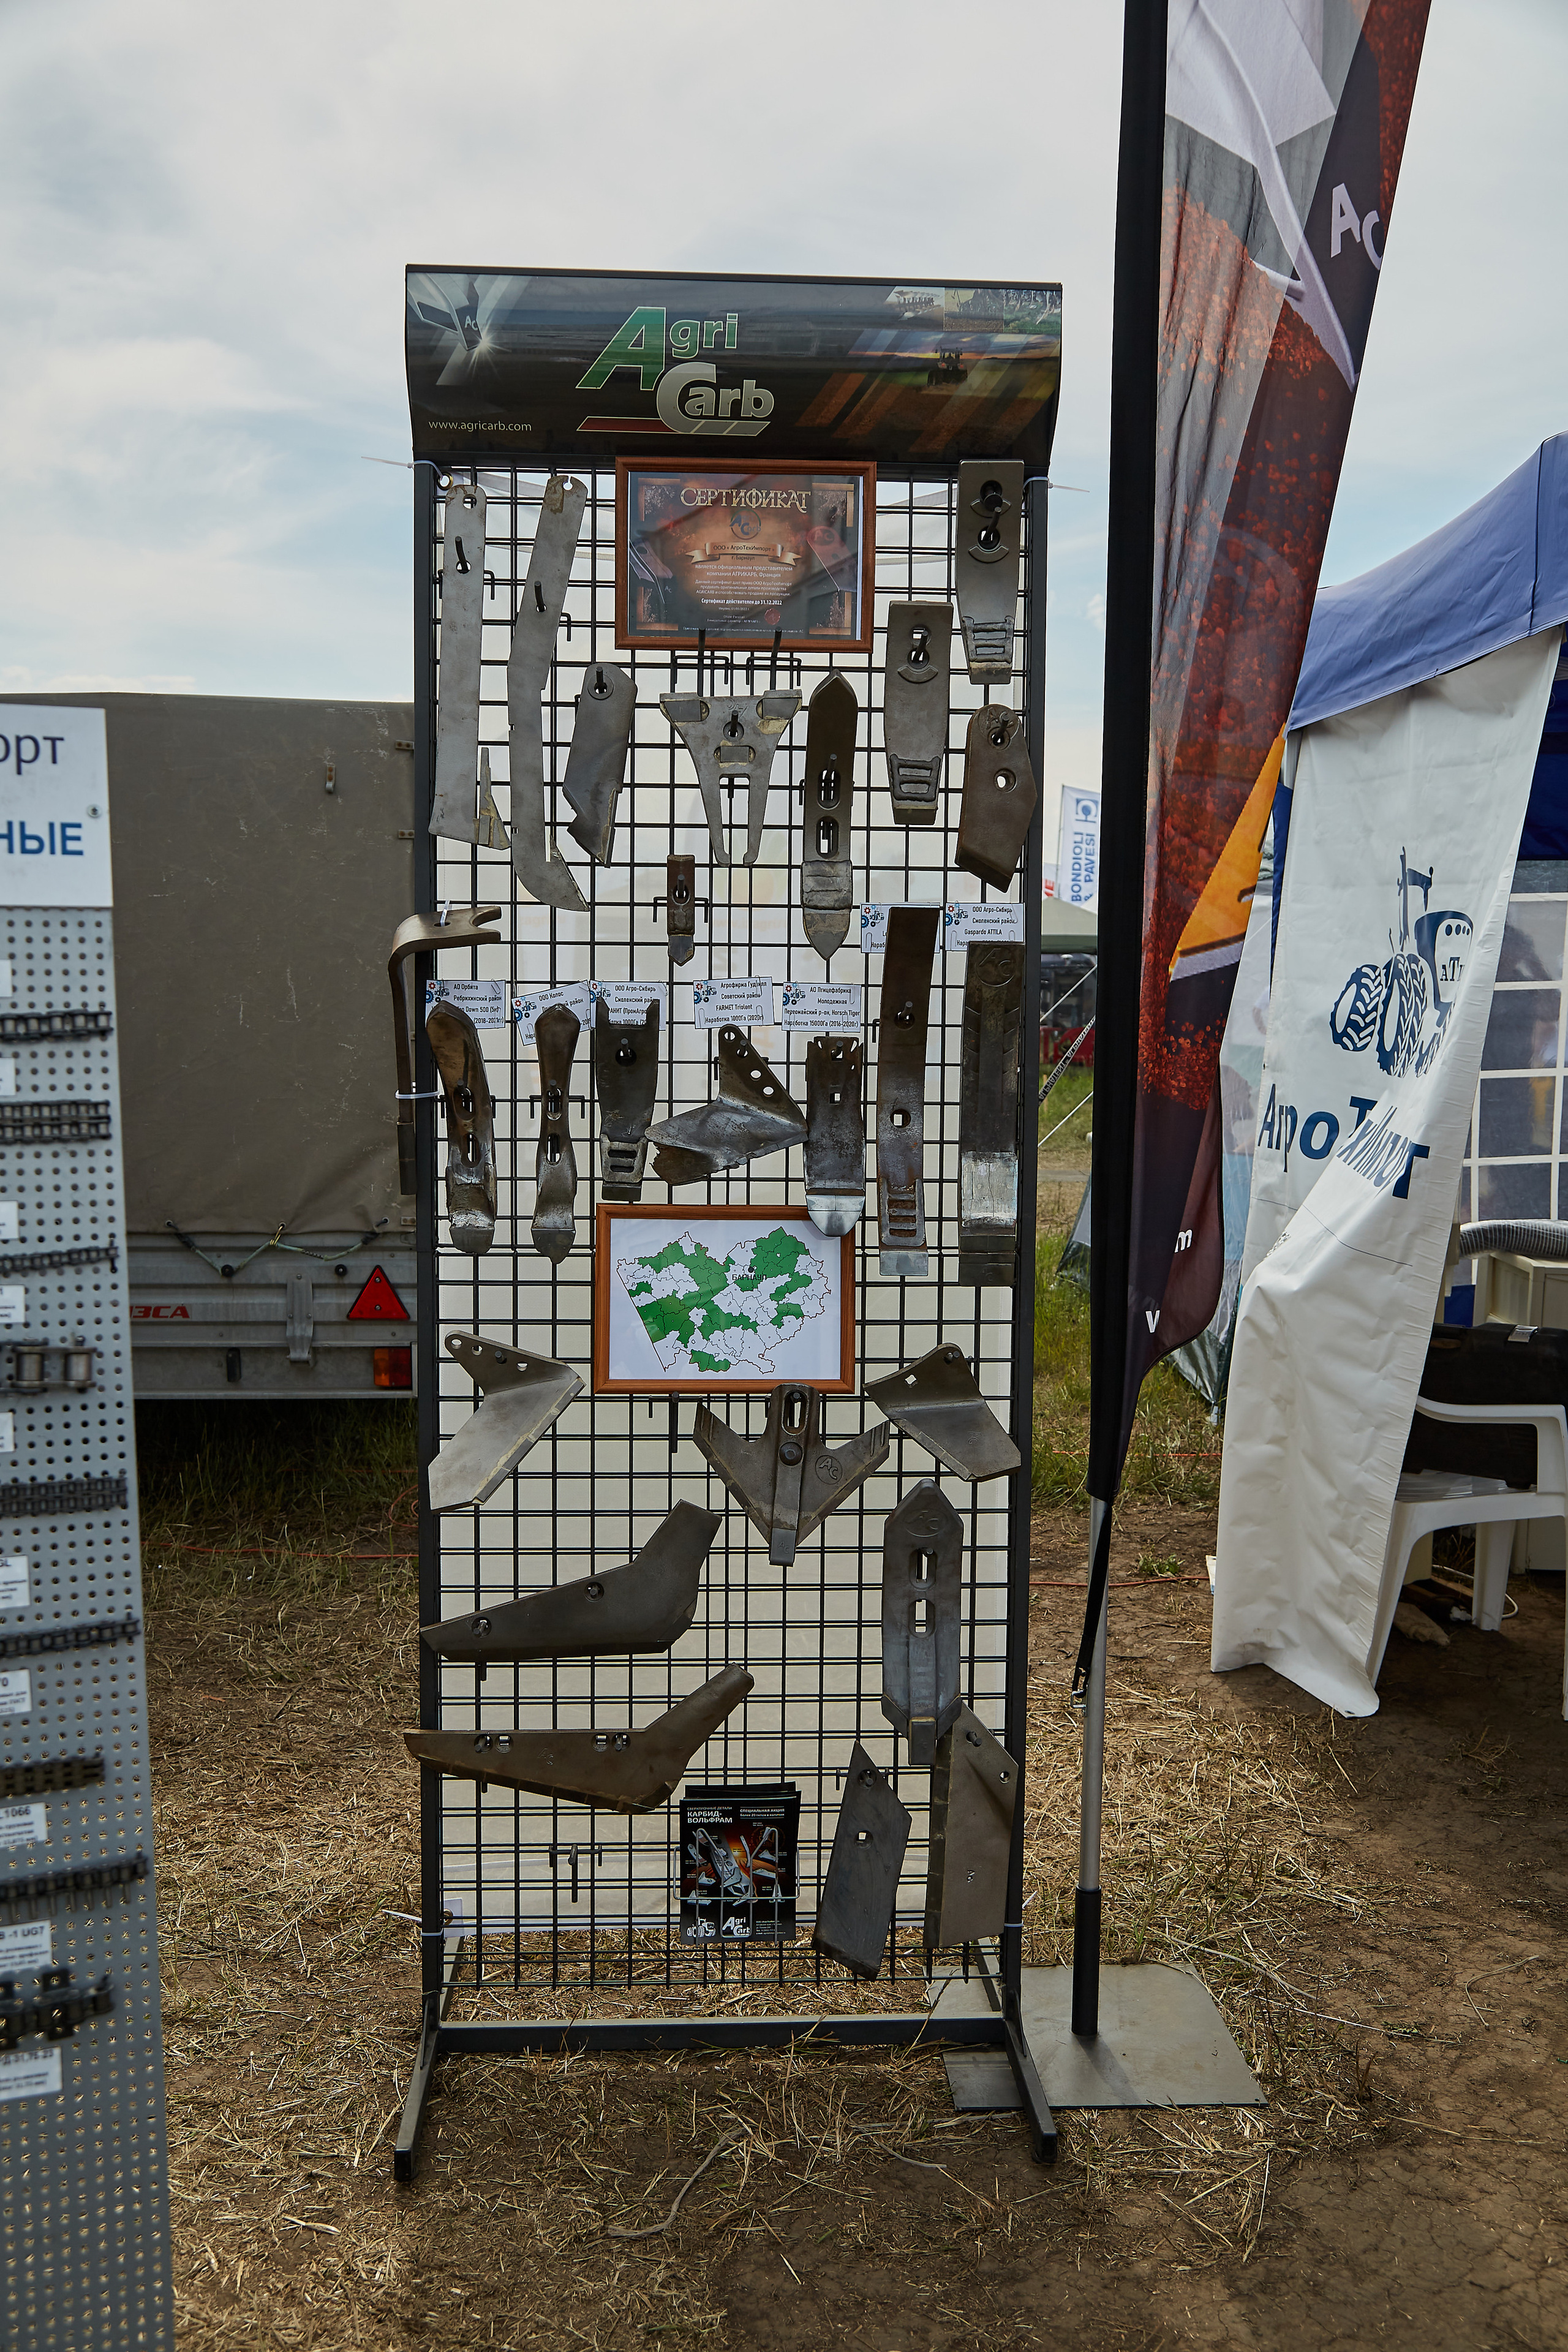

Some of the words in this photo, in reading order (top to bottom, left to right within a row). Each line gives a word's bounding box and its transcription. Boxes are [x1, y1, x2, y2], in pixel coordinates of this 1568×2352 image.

[576, 306, 738, 391] Agri
[657, 361, 774, 434] Carb
[428, 420, 532, 432] www.agricarb.com
[680, 487, 811, 513] СЕРТИФИКАТ
[1071, 831, 1084, 902] BONDIOLI
[1084, 833, 1095, 883] PAVESI
[569, 997, 584, 1007] район
[130, 1305, 190, 1319] ЗСА
[819, 1458, 838, 1480] AC
[722, 1917, 746, 1930] Agri
